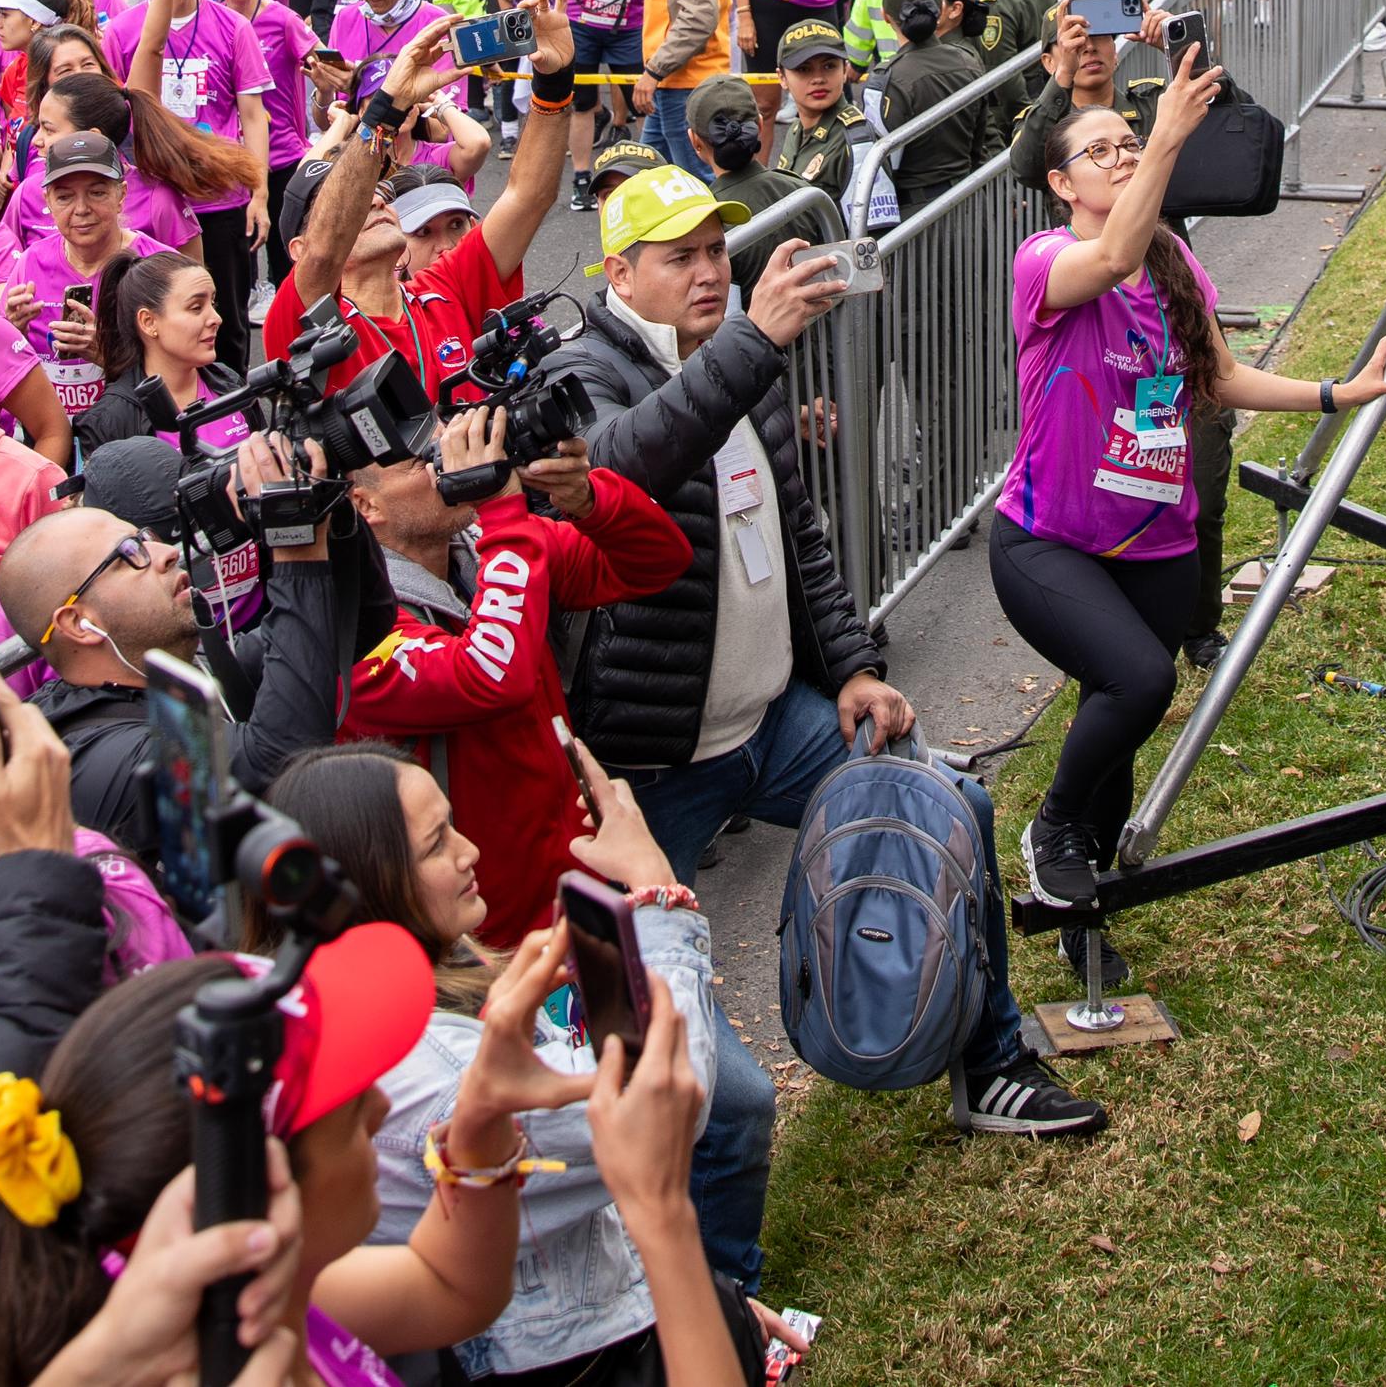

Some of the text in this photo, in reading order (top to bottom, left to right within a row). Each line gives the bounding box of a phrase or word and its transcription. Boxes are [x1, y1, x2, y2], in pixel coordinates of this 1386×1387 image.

[785, 24, 840, 44] POLICIA
[594, 145, 656, 170] POLICIA
[649, 169, 711, 207] idu
[56, 384, 98, 406] 5062
[1139, 406, 1177, 418] PRENSA
[466, 550, 531, 682] IDRD
